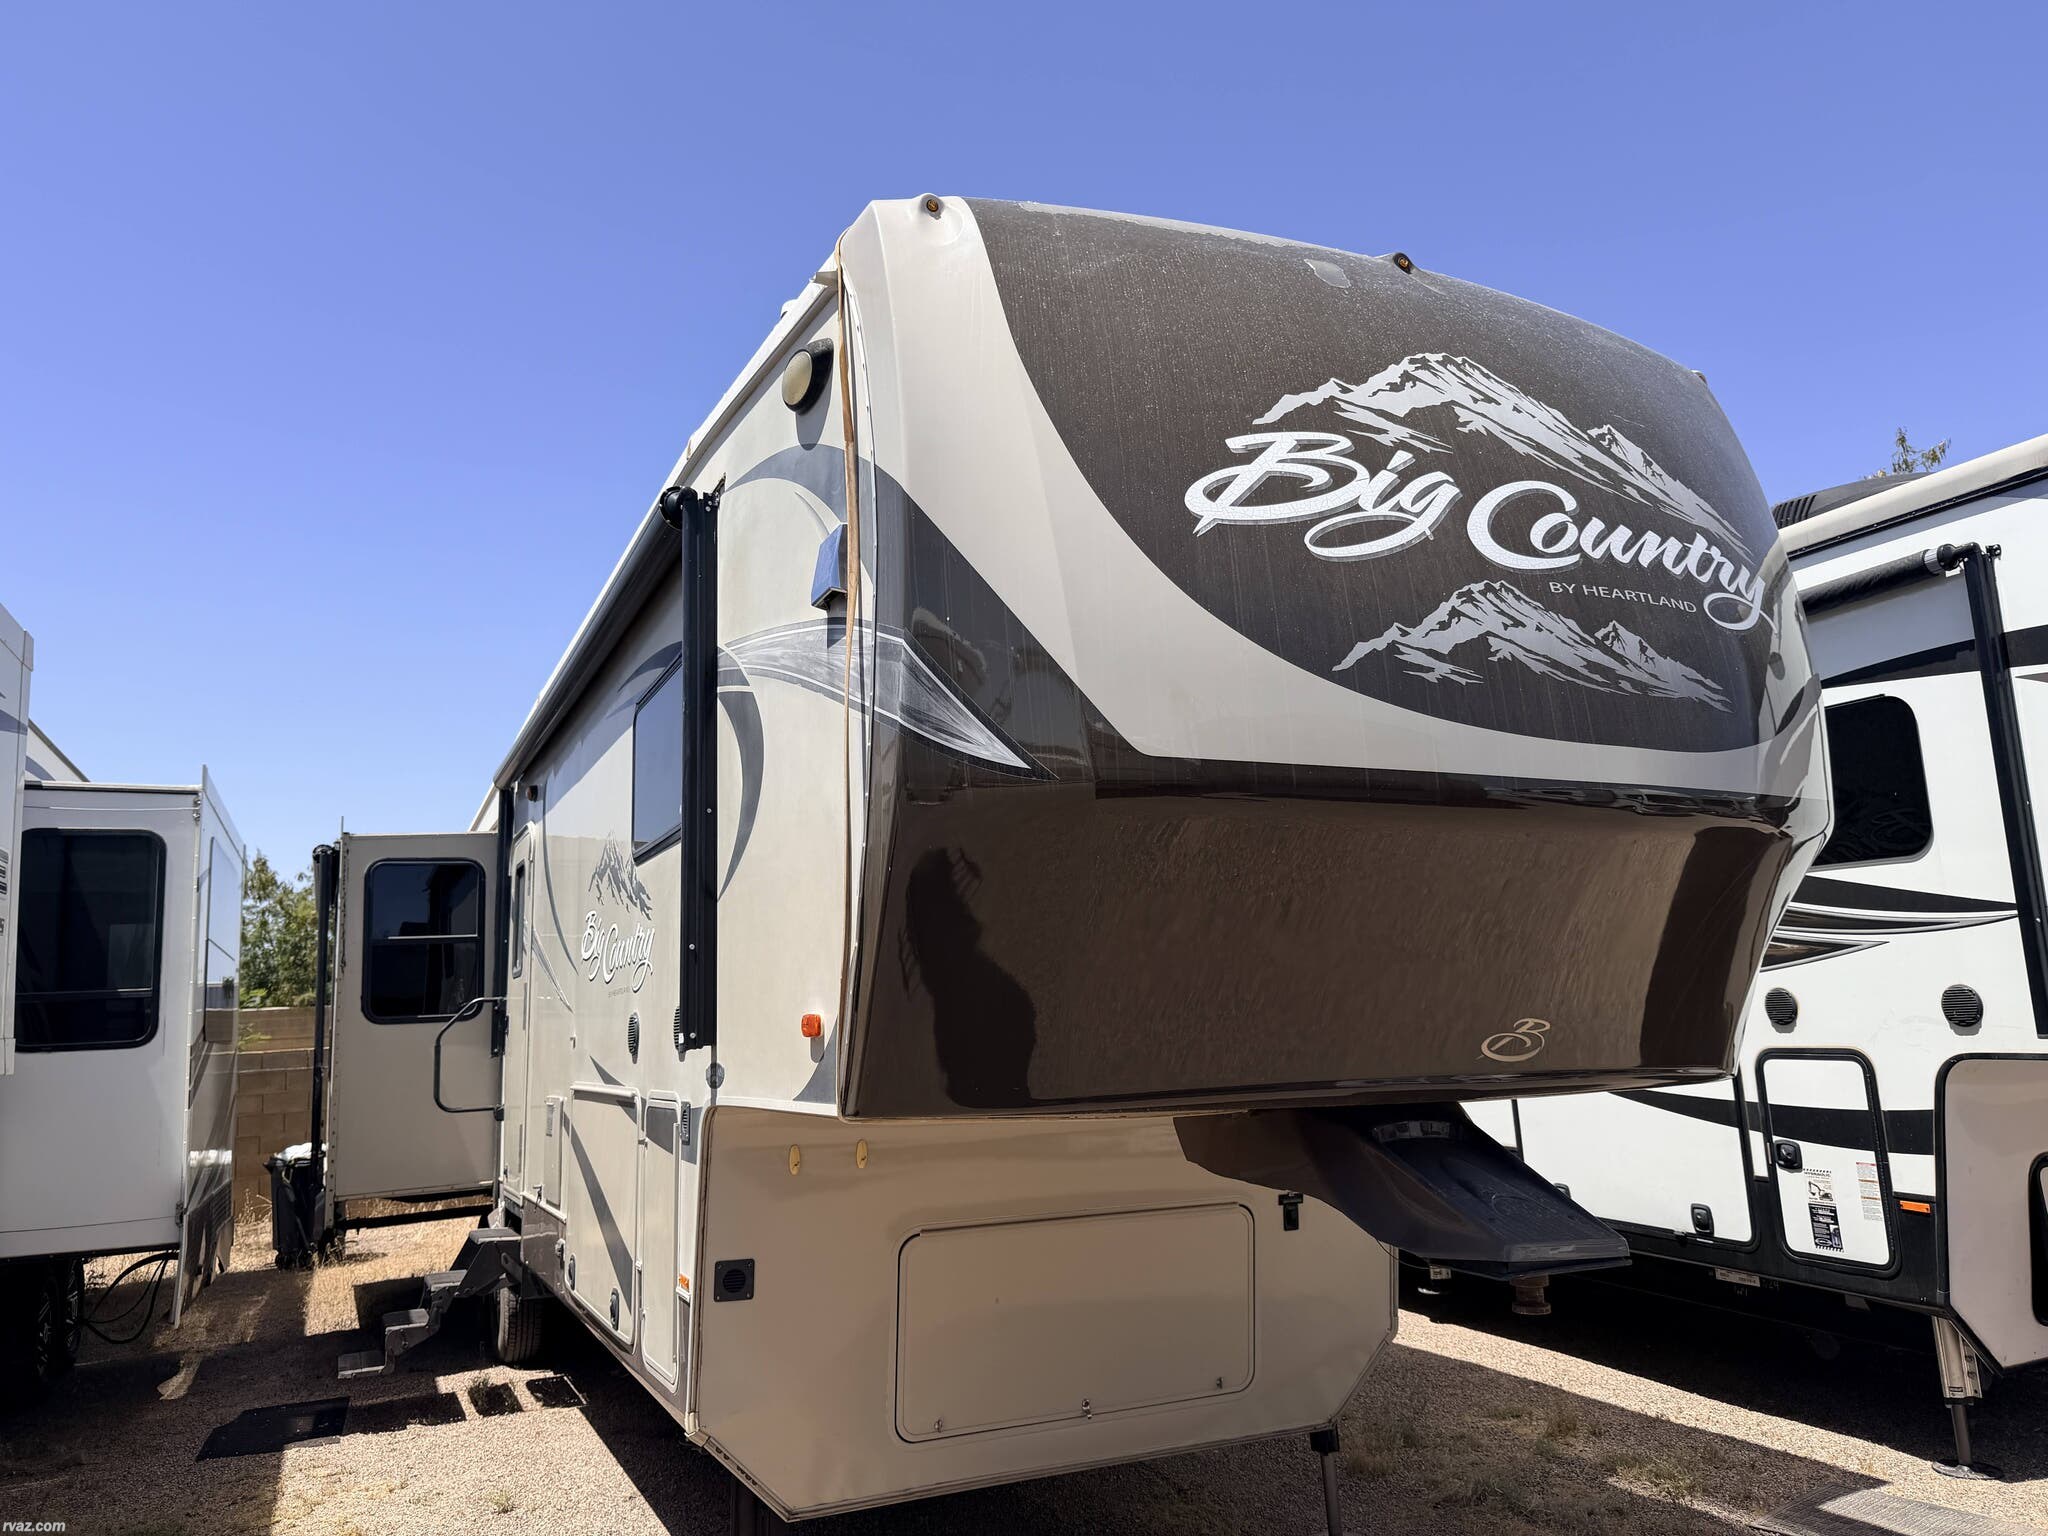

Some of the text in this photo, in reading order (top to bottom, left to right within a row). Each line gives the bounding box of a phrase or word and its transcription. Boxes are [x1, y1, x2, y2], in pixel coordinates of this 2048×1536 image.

[1184, 431, 1779, 635] Big Country
[1549, 582, 1697, 613] BY HEARTLAND
[581, 910, 655, 993] Big Country
